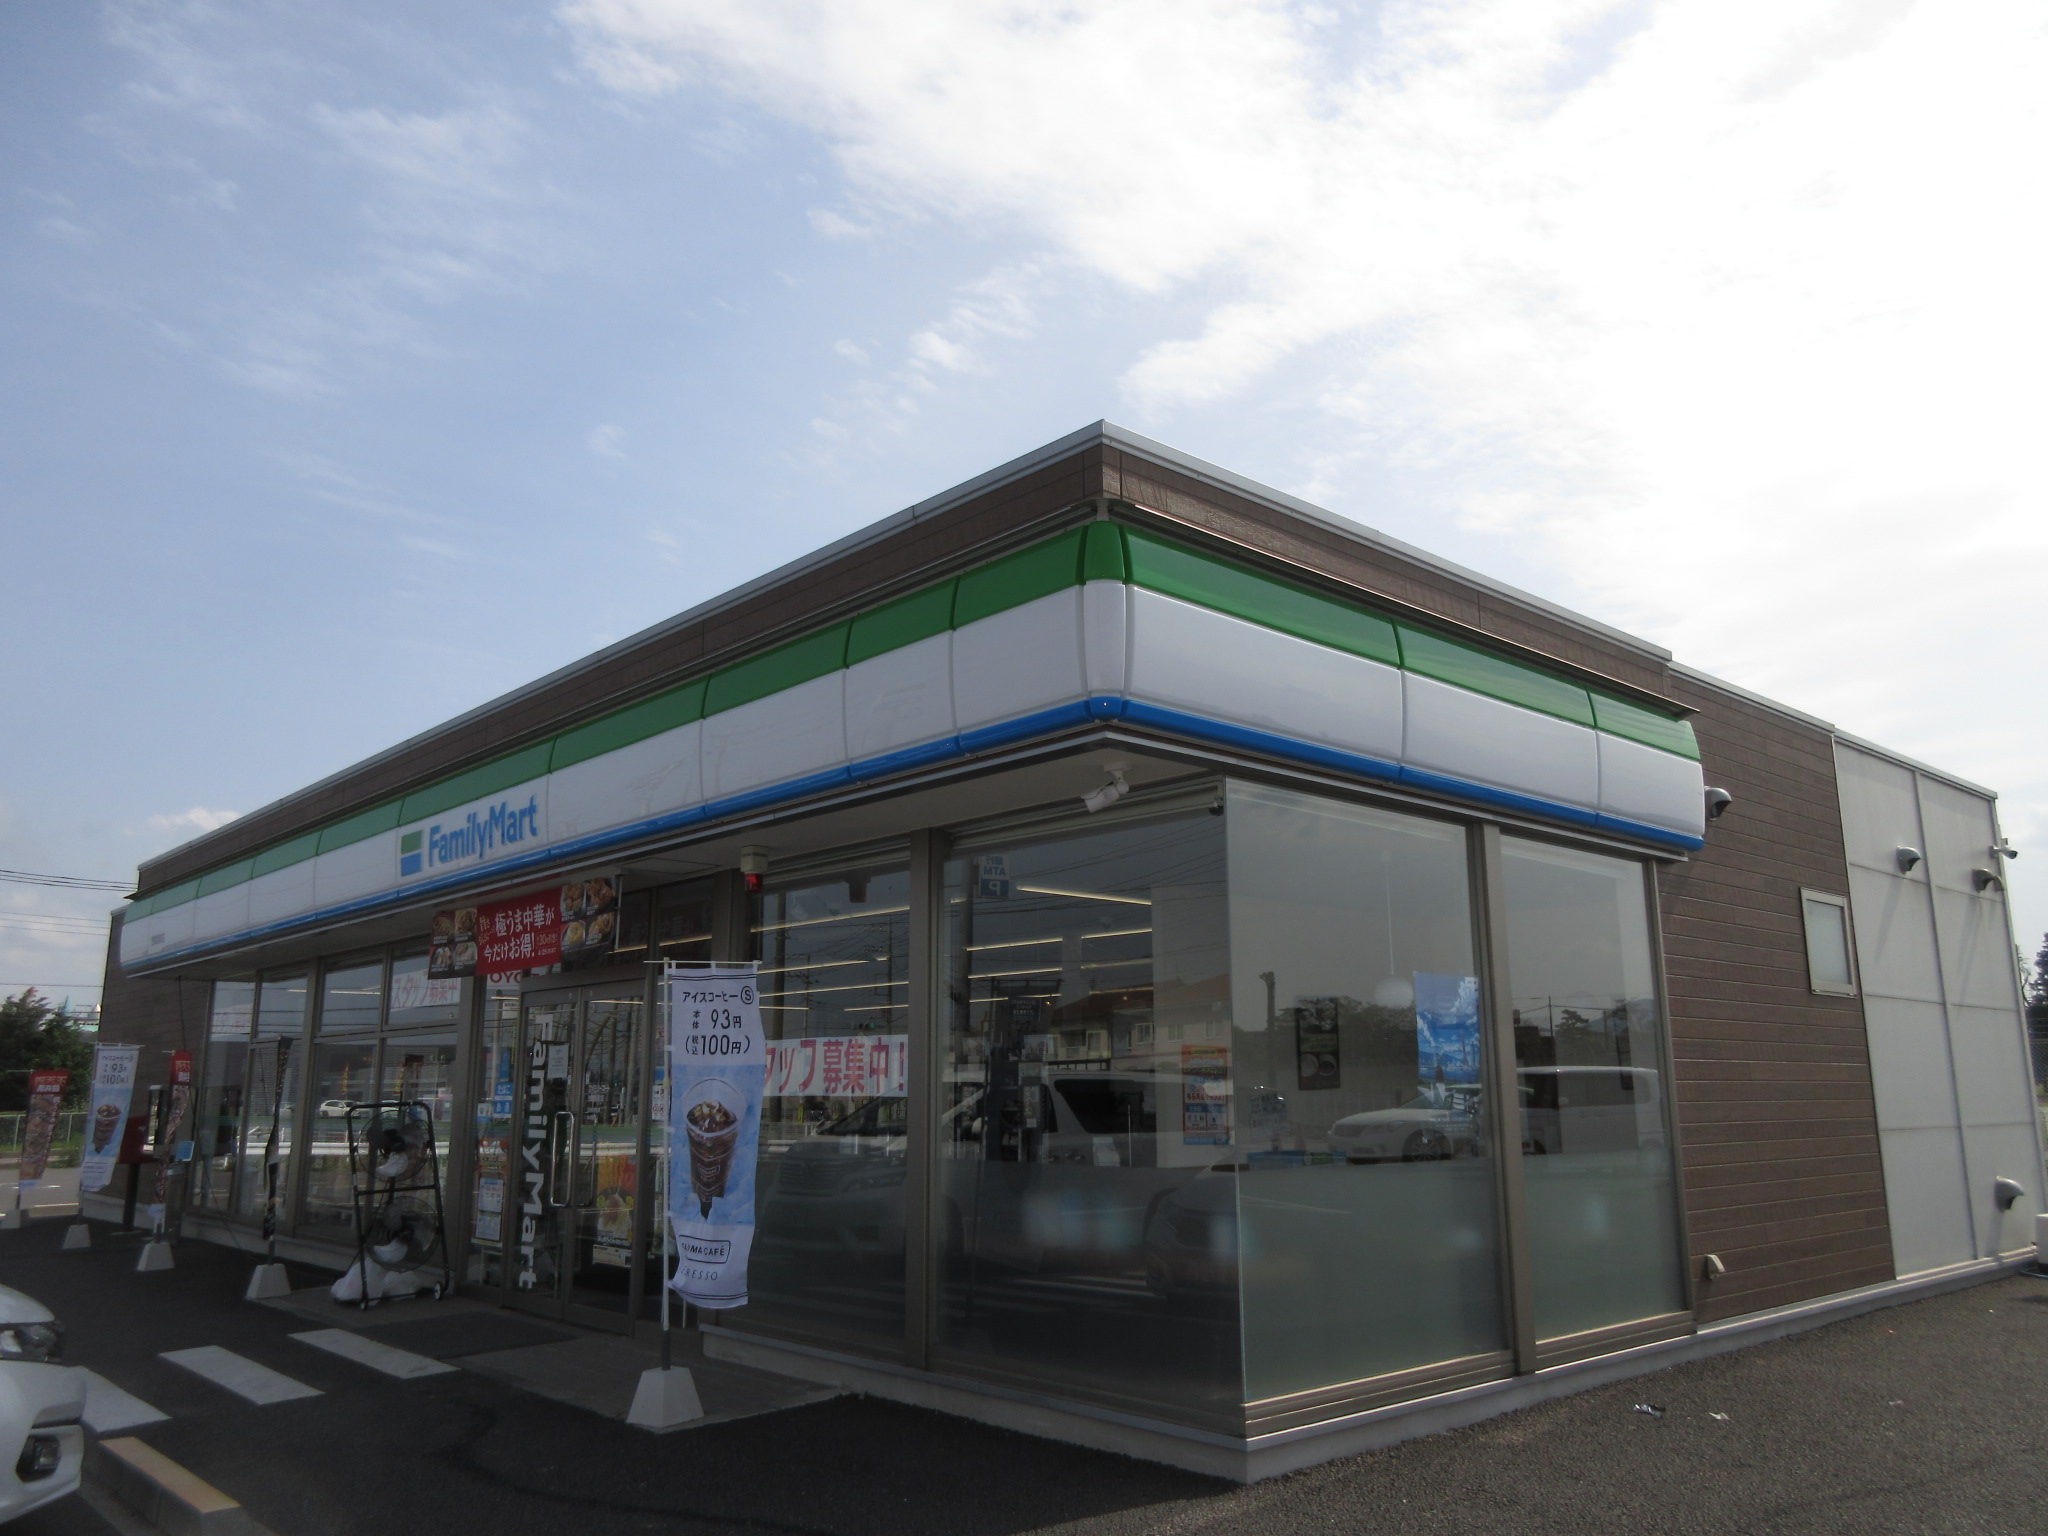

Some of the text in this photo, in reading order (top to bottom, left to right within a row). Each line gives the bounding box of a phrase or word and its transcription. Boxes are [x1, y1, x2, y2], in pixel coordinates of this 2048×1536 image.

[429, 793, 539, 868] FamilyMart
[495, 903, 555, 938] 極うま中華が
[483, 931, 535, 964] 今だけお得!
[710, 1008, 742, 1030] 93円
[518, 1013, 554, 1290] FamilyMart
